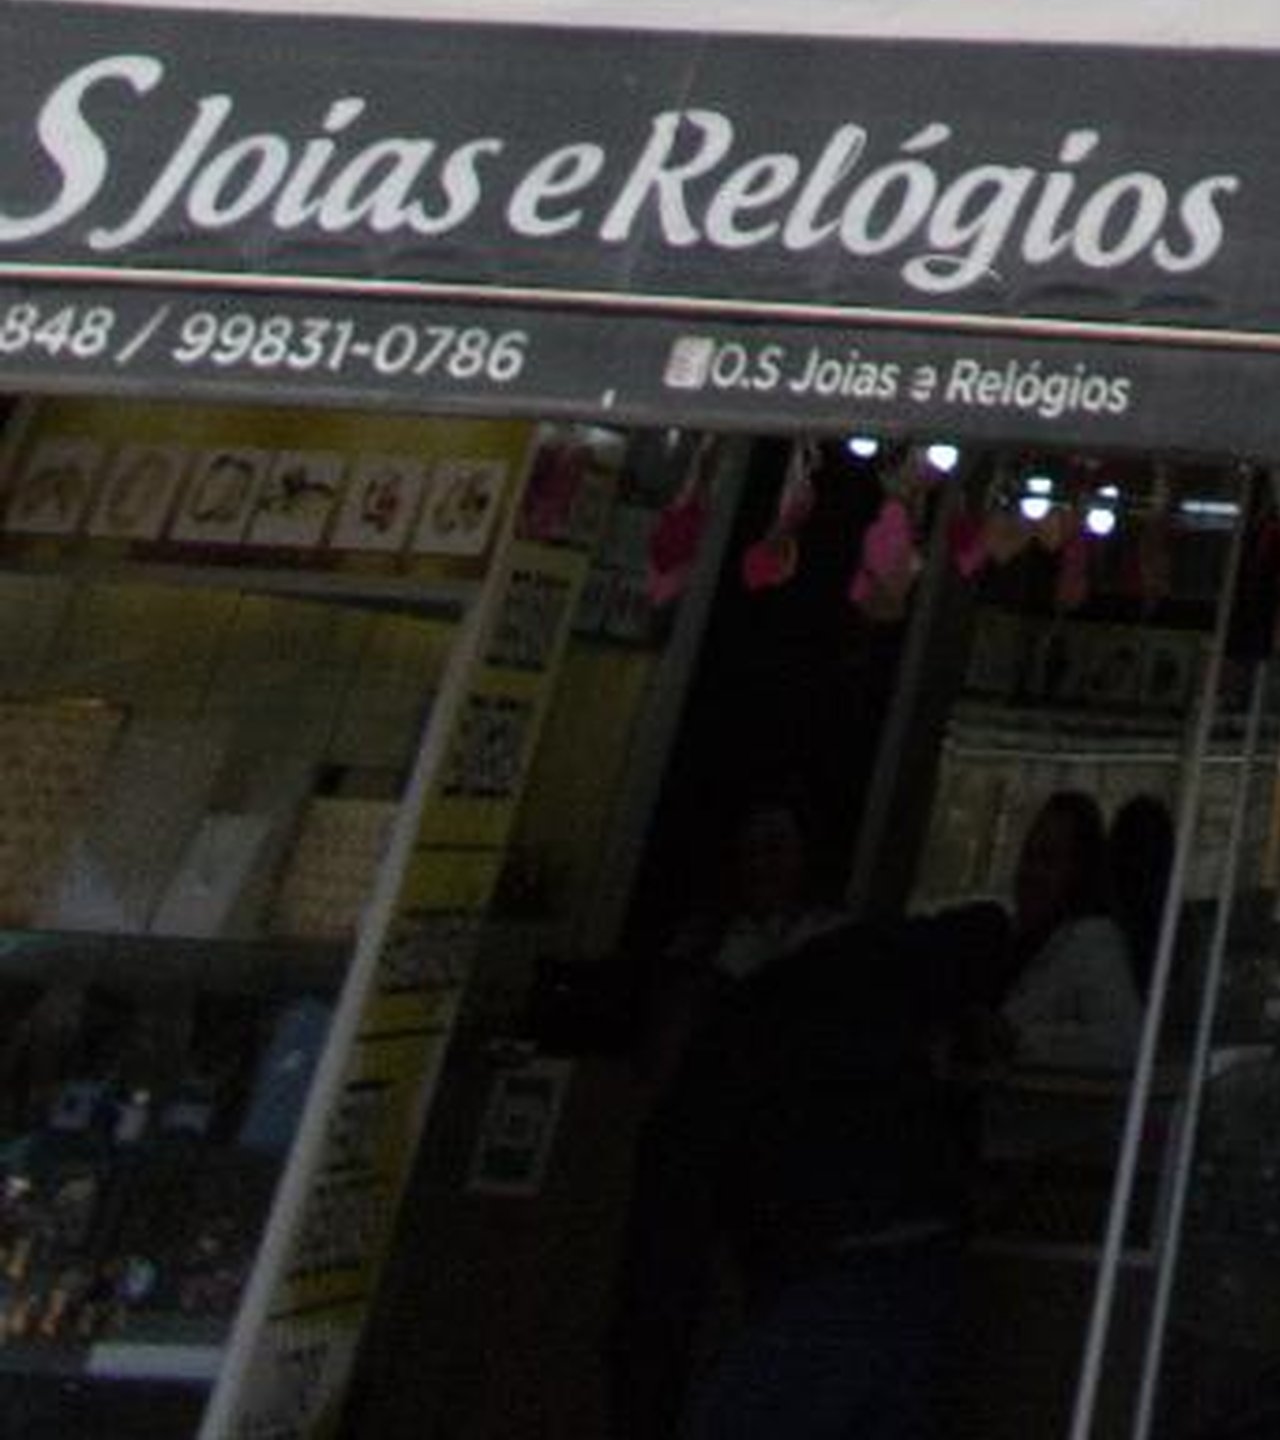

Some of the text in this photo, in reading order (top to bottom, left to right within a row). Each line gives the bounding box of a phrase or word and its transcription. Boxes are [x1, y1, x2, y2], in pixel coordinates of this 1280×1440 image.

[89, 94, 503, 250] Joias
[507, 142, 604, 236] e
[600, 108, 1239, 293] Relógios
[172, 310, 528, 382] 99831-0786
[711, 339, 783, 389] O.S
[790, 348, 898, 401] Joias
[945, 358, 1131, 422] Relógios
